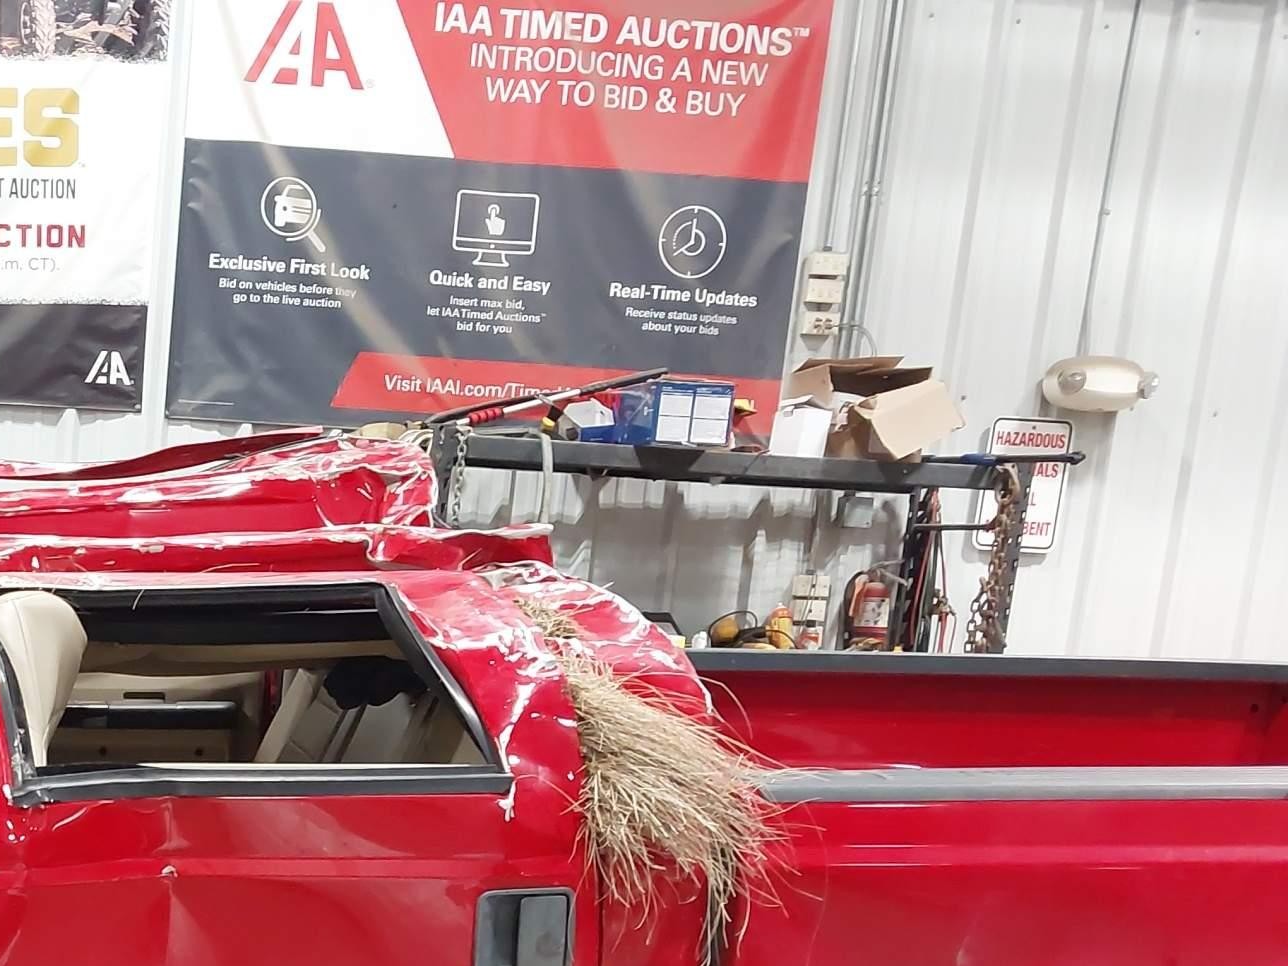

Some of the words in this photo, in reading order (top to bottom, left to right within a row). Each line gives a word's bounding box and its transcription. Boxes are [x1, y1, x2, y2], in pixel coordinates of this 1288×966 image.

[434, 1, 493, 37] IAA
[500, 8, 609, 43] TIMED
[470, 43, 666, 81] INTRODUCING
[671, 57, 692, 82] A
[701, 59, 769, 87] NEW
[485, 77, 550, 105] WAY
[557, 80, 595, 107] TO
[603, 84, 648, 111] BID
[655, 88, 677, 114] &
[685, 89, 746, 117] BUY
[9, 178, 77, 199] AUCTION
[28, 257, 60, 272] CT).
[209, 253, 286, 273] Exclusive
[290, 258, 327, 276] First
[331, 262, 371, 280] Look
[219, 277, 237, 289] Bid
[239, 281, 253, 290] on
[255, 280, 297, 293] vehicles
[299, 283, 333, 295] before
[335, 287, 357, 299] they
[429, 269, 474, 288] Quick
[477, 275, 509, 290] and
[512, 276, 551, 295] Easy
[233, 293, 247, 304] go
[249, 293, 260, 303] to
[263, 294, 280, 304] the
[282, 294, 300, 306] live
[302, 297, 342, 308] auction
[450, 295, 478, 307] Insert
[480, 299, 502, 309] max
[506, 299, 525, 310] bid,
[609, 282, 691, 302] Real-Time
[694, 288, 758, 307] Updates
[427, 306, 440, 316] let
[442, 307, 460, 318] IAA
[460, 308, 493, 320] Timed
[625, 306, 666, 319] Receive
[667, 310, 697, 321] status
[699, 313, 737, 325] updates
[456, 321, 473, 331] bid
[475, 321, 491, 332] for
[492, 325, 513, 335] you
[641, 321, 672, 332] about
[674, 324, 697, 335] your
[699, 324, 719, 335] bids
[384, 374, 422, 392] Visit
[426, 378, 572, 399] IAAI.com/Tim
[996, 431, 1066, 449] HAZARDOUS
